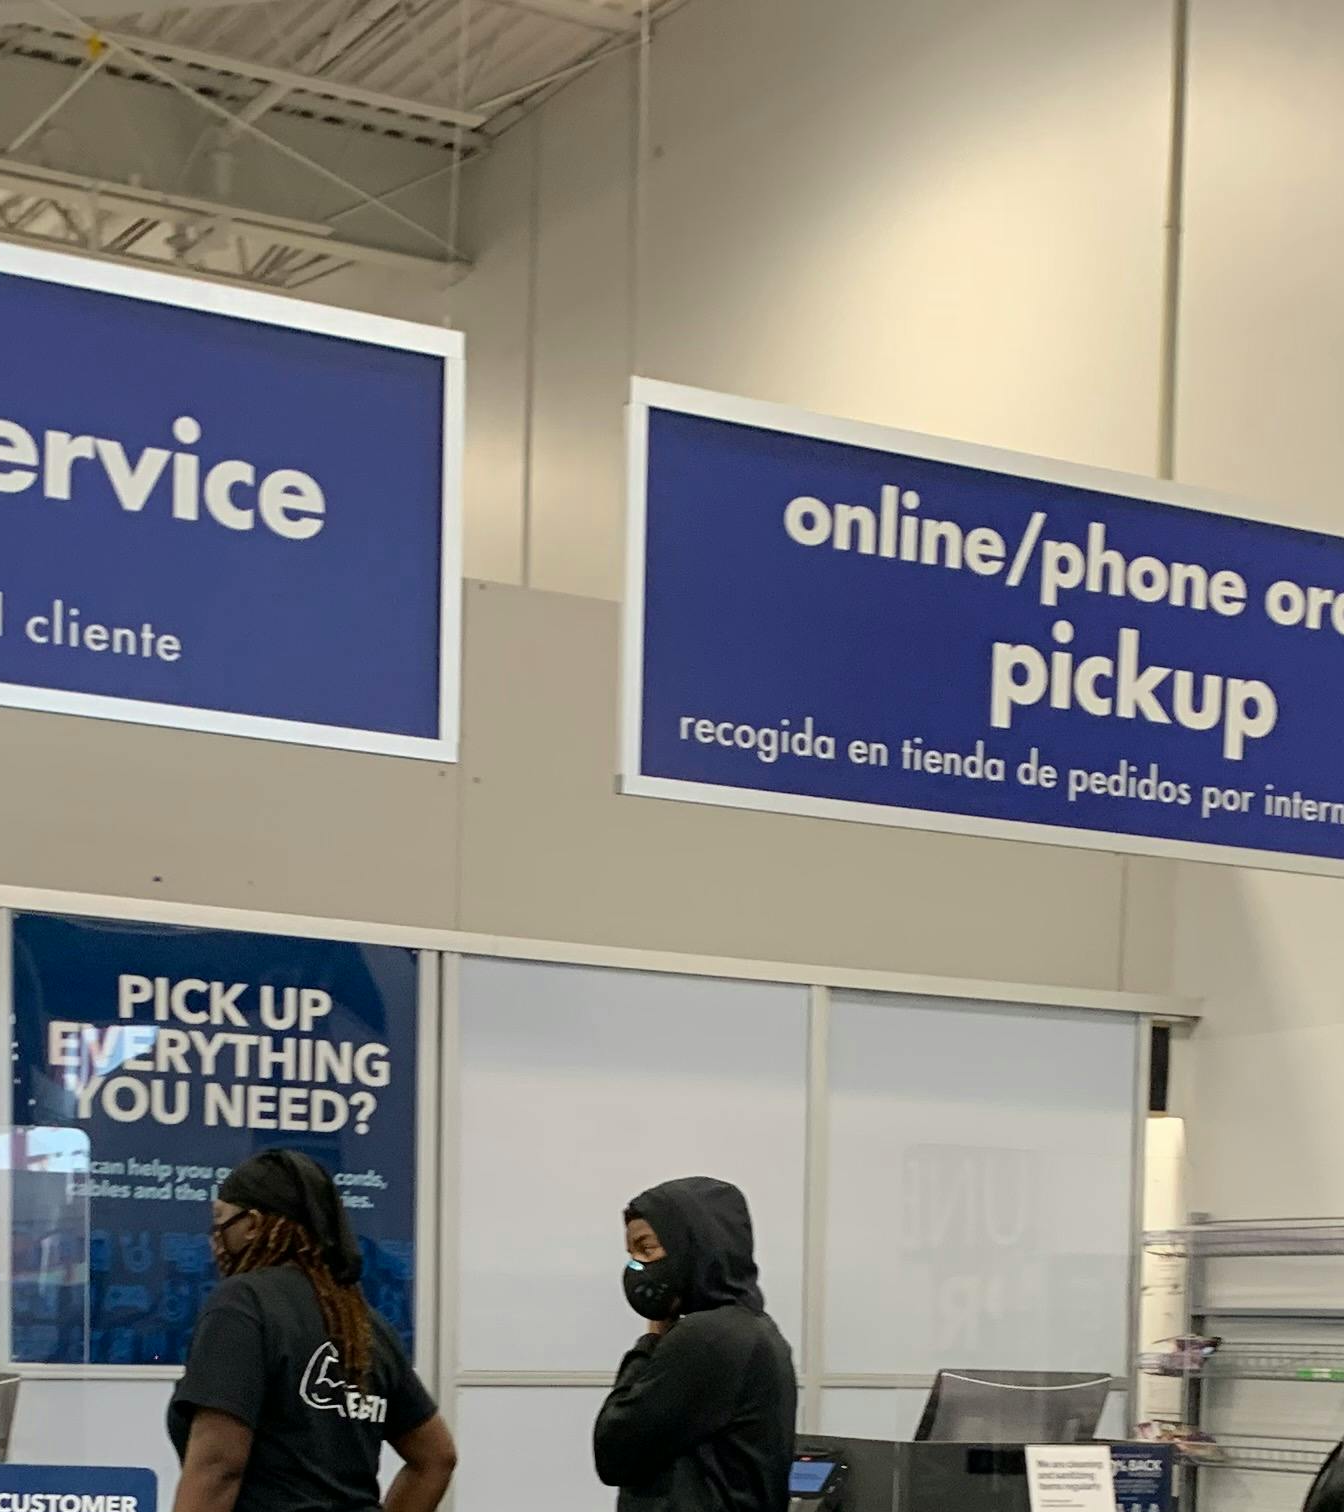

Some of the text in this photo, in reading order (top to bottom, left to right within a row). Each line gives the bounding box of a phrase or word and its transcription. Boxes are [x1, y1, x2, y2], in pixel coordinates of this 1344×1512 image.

[784, 484, 1247, 617] online/phone
[26, 600, 183, 662] cliente
[990, 620, 1278, 761] pickup
[680, 716, 836, 763] recogida
[848, 739, 889, 767] en
[902, 737, 1005, 782] tienda
[1017, 747, 1058, 789] de
[1068, 759, 1192, 806] pedidos
[1202, 785, 1256, 819] por
[118, 973, 332, 1033] PICK UP
[47, 1021, 391, 1088] EVERYTHING
[65, 1074, 378, 1136] YOU NEED?
[67, 1179, 132, 1200] cables
[134, 1182, 173, 1200] and
[175, 1183, 207, 1201] the
[90, 1161, 125, 1176] can
[127, 1157, 173, 1182] help
[176, 1166, 213, 1183] you
